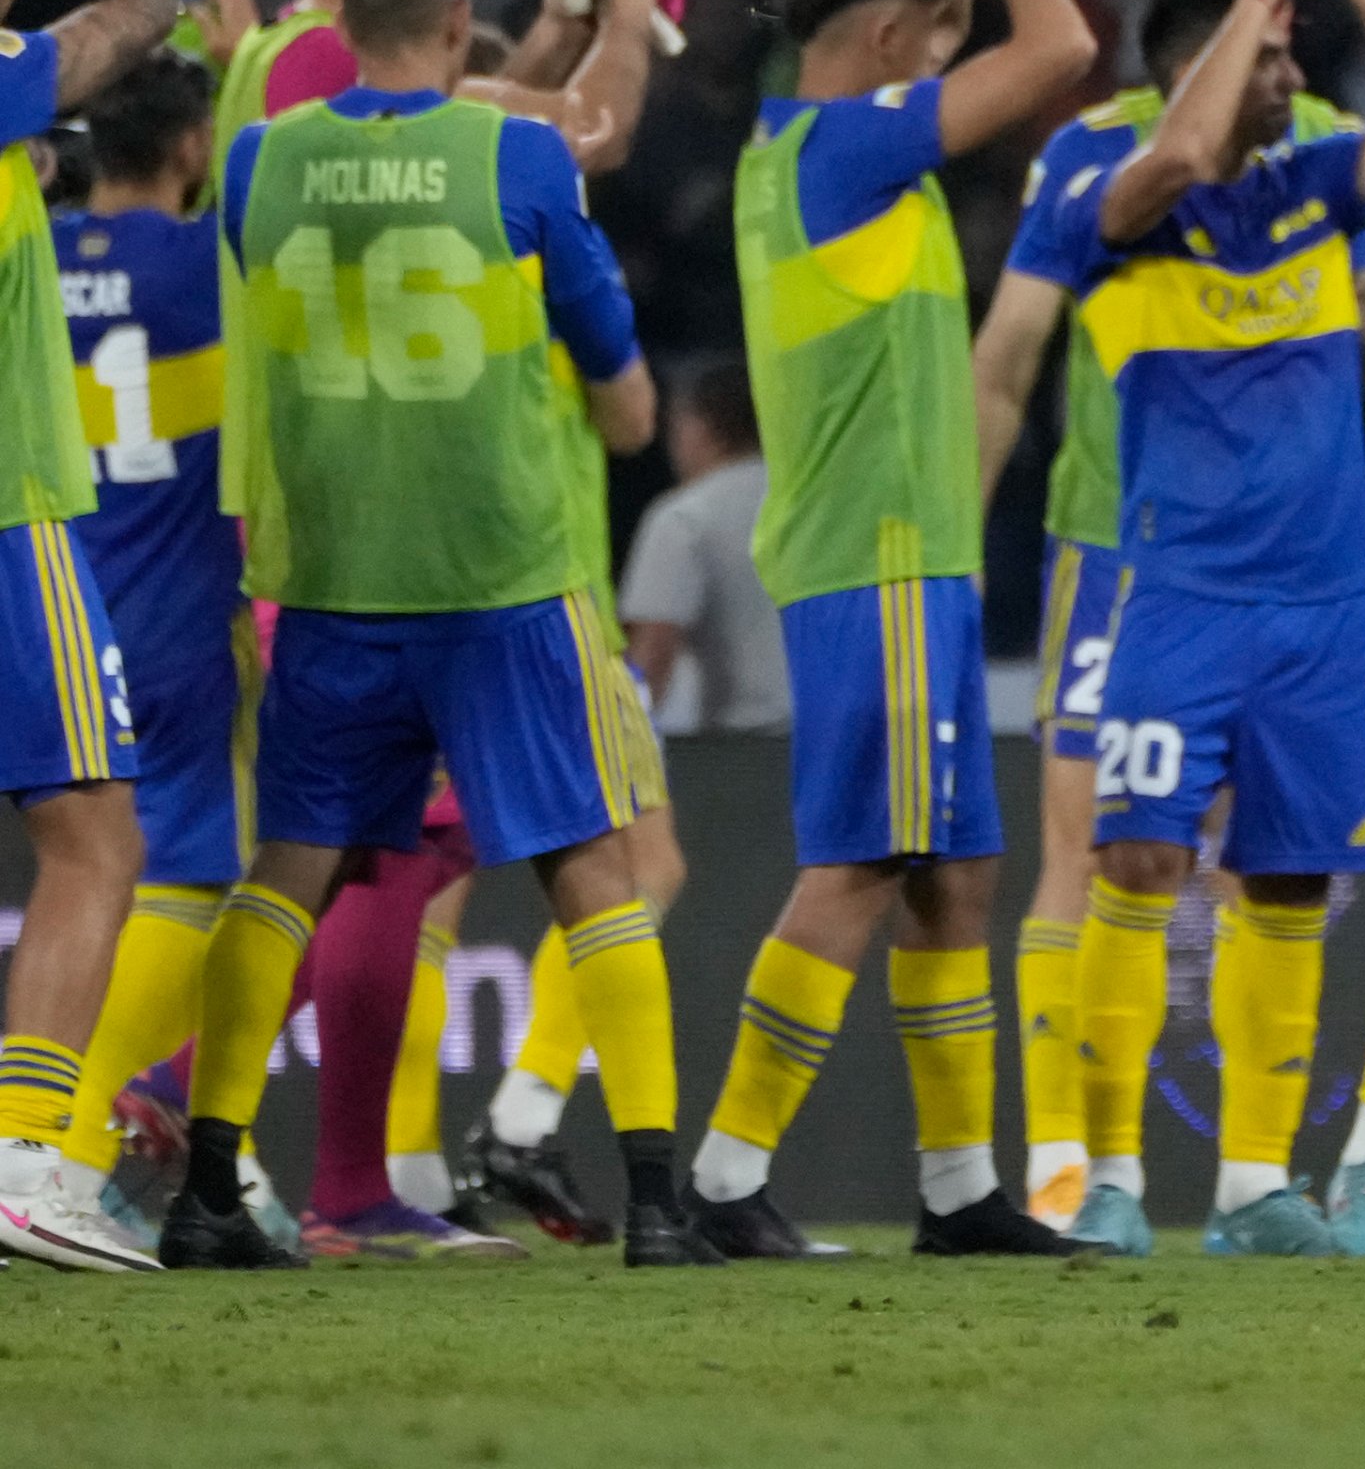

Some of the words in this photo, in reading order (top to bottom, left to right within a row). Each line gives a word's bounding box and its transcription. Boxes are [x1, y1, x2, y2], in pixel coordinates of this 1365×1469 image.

[302, 158, 448, 204] MOLINAS
[273, 224, 486, 401] 16
[1094, 717, 1185, 798] 20
